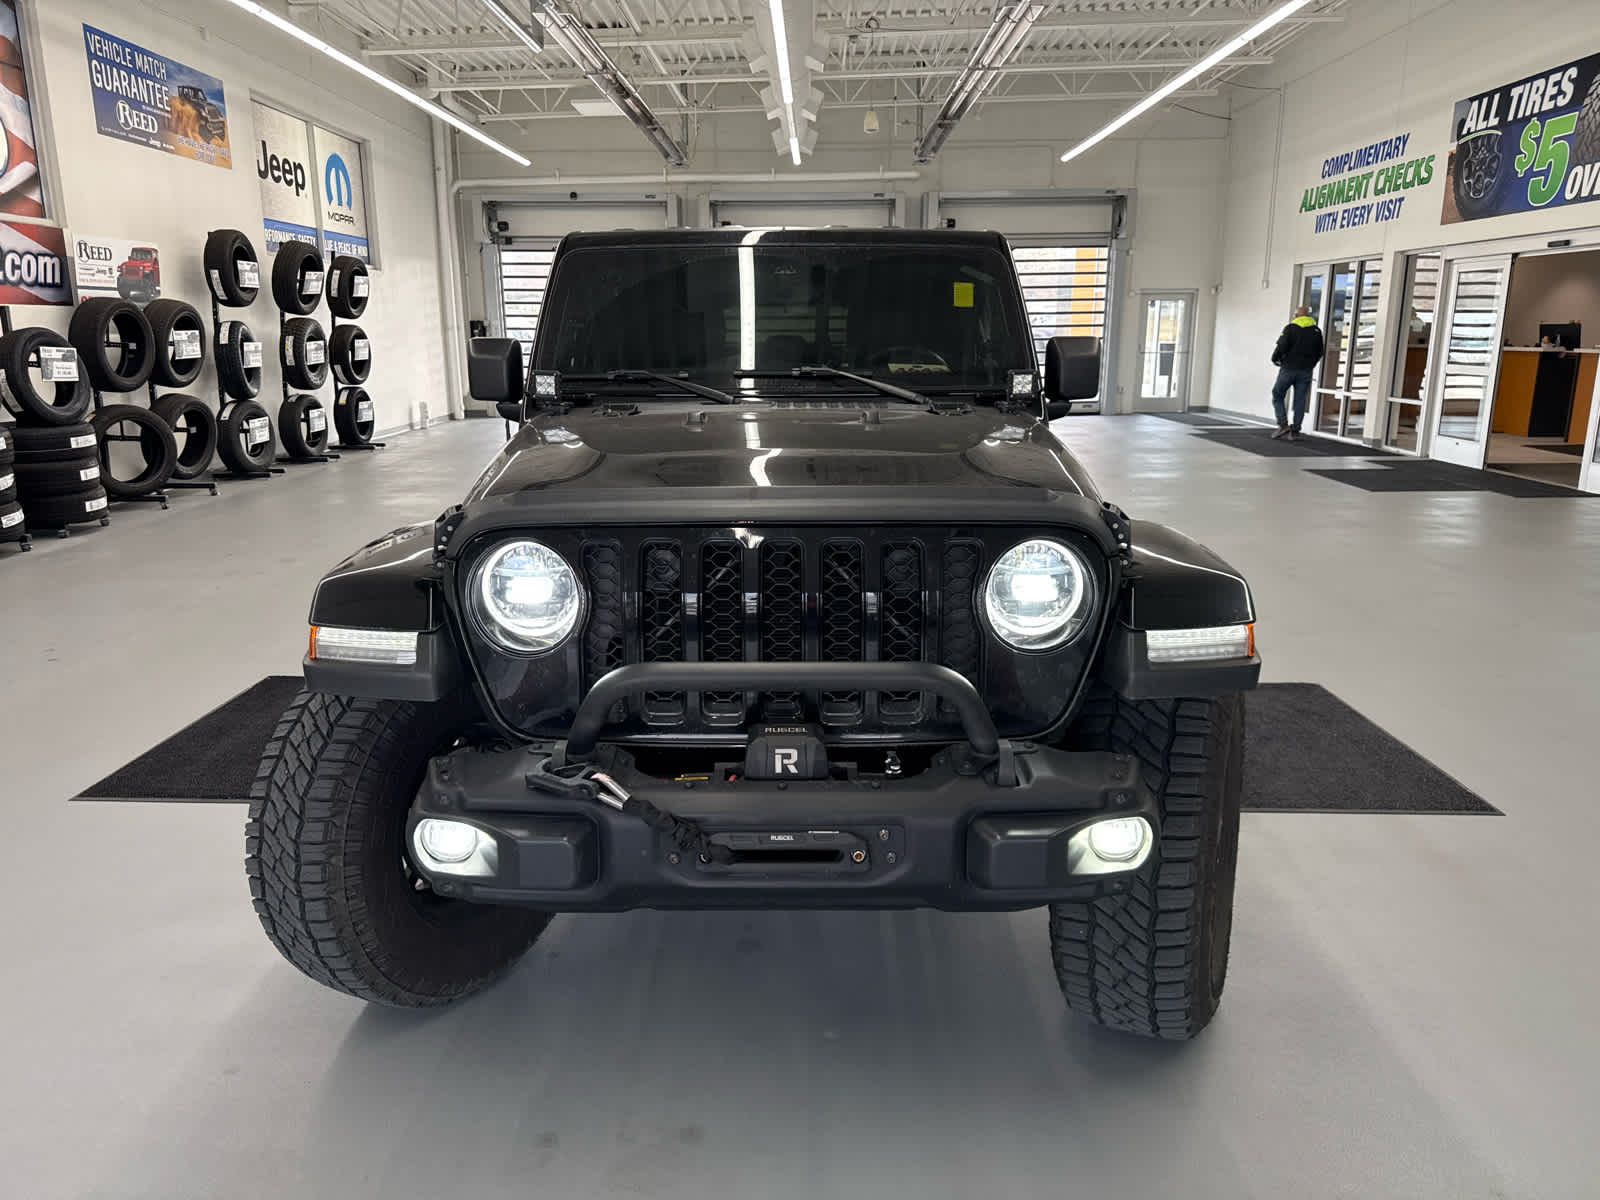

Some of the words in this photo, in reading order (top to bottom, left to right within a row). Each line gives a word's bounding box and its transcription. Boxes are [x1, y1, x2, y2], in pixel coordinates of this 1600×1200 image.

[87, 31, 133, 69] VEHICLE
[134, 51, 167, 81] MATCH
[91, 59, 171, 112] GUARANTEE
[1461, 92, 1501, 135] ALL
[1507, 66, 1578, 122] TIRES
[116, 100, 159, 134] REED
[256, 139, 306, 197] Jeep
[1321, 132, 1411, 180] COMPLIMENTARY
[1514, 111, 1579, 207] $5
[1299, 170, 1374, 214] ALIGNMENT
[1373, 154, 1436, 197] CHECKS
[327, 210, 355, 225] MOPAR
[1314, 210, 1339, 234] WITH
[1340, 202, 1374, 230] EVERY
[1375, 196, 1405, 223] VISIT
[76, 239, 113, 263] REED
[775, 748, 799, 773] R
